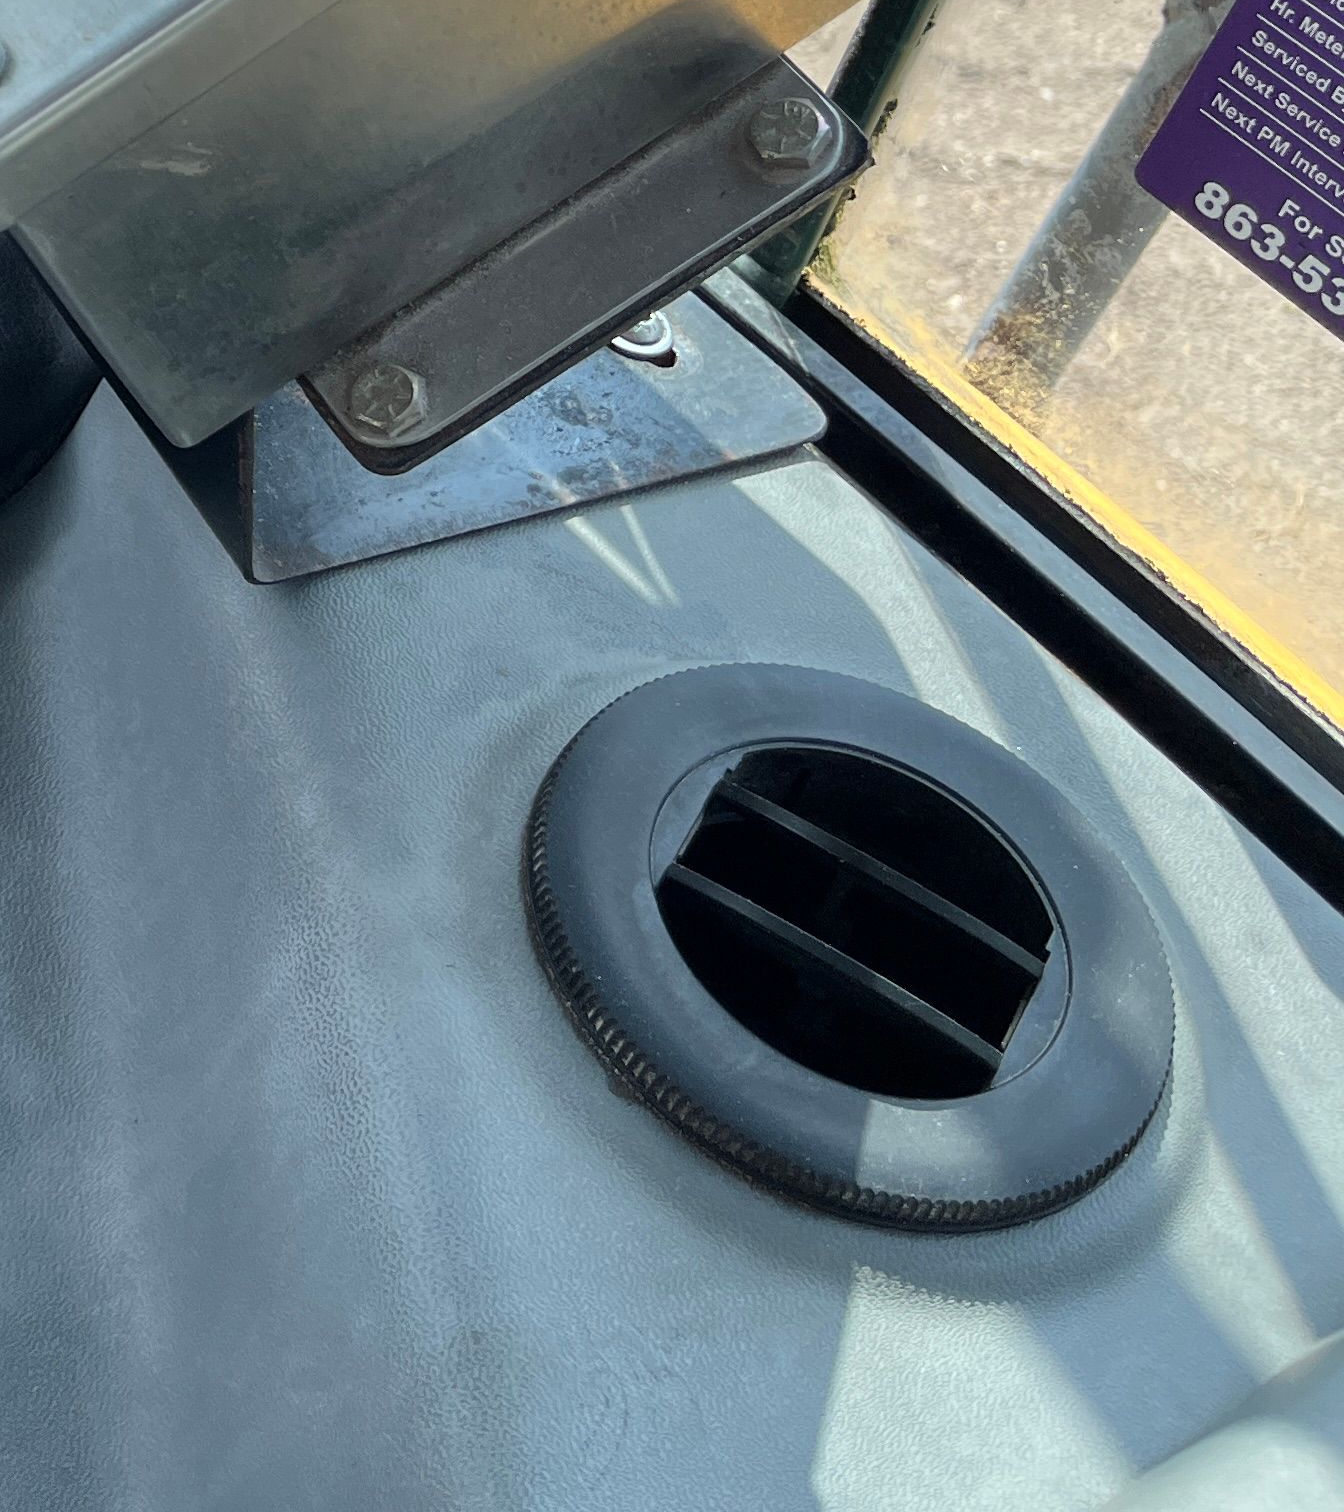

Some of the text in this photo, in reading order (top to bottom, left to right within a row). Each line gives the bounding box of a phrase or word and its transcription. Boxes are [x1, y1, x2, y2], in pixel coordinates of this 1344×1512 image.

[1251, 30, 1332, 93] Serviced
[1211, 92, 1257, 133] Next
[1257, 125, 1291, 157] PM
[1231, 60, 1341, 147] Next Service
[1278, 199, 1323, 240] For
